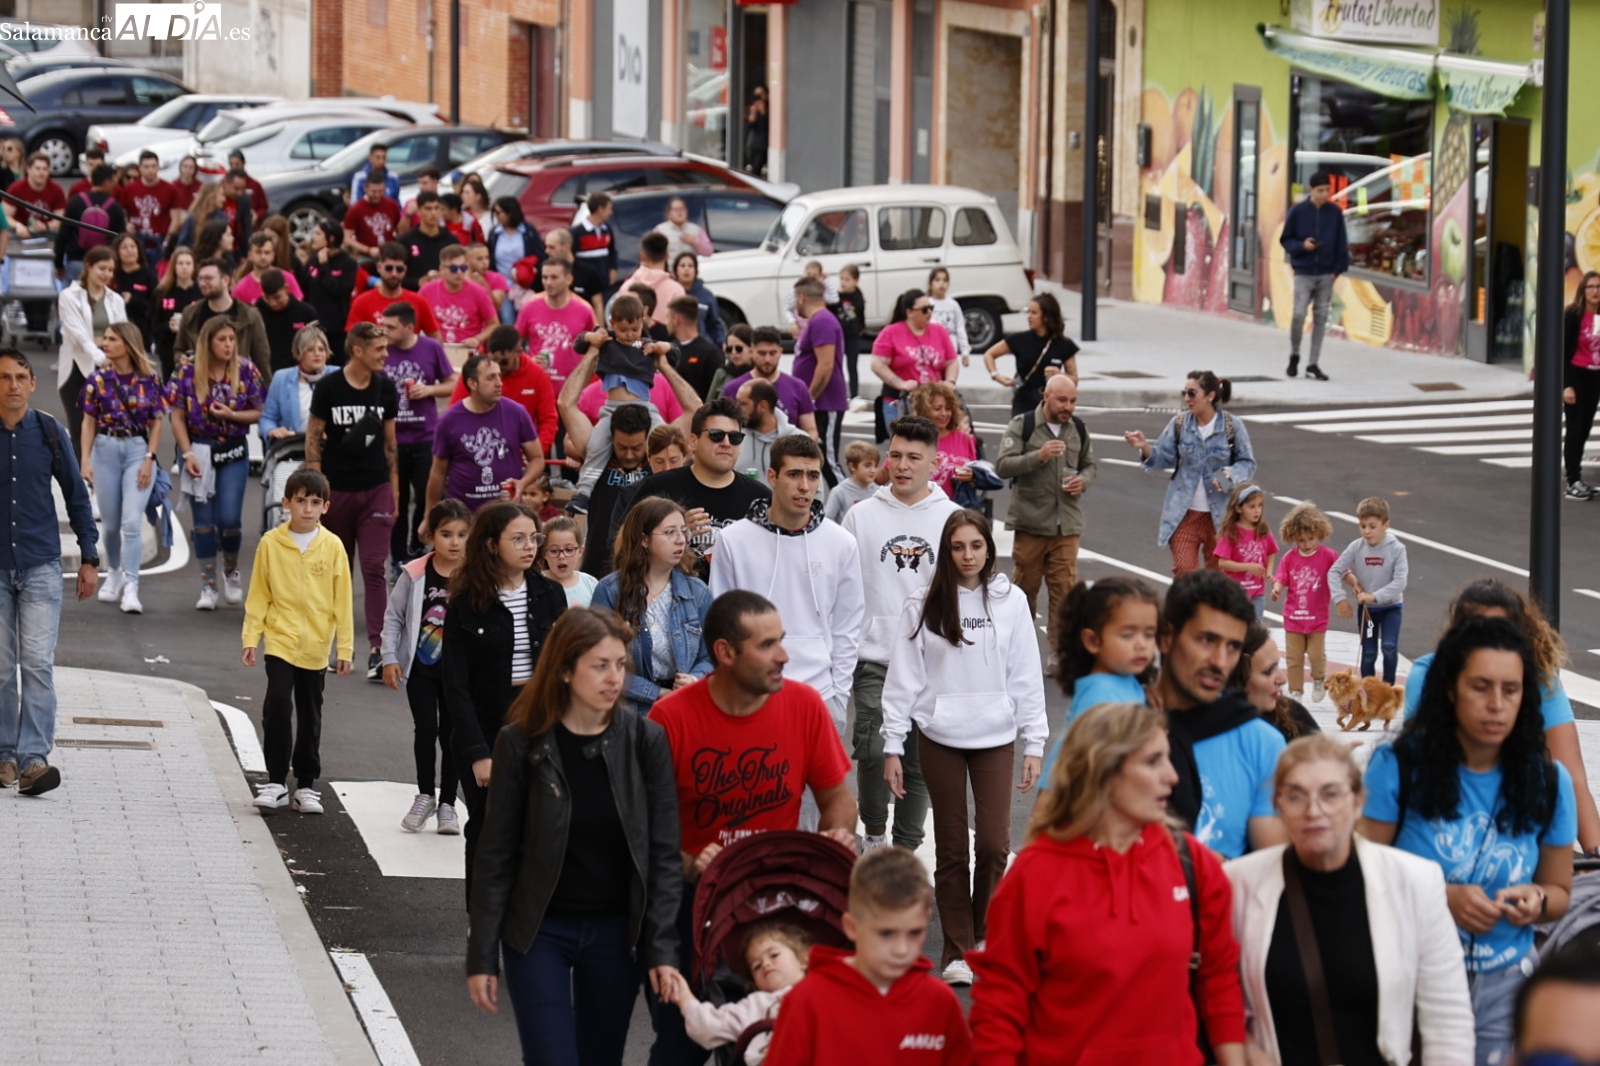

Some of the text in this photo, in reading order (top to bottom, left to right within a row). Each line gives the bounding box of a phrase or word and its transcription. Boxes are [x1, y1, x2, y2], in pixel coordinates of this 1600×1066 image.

[691, 743, 790, 796] The True
[694, 776, 793, 829] Originals
